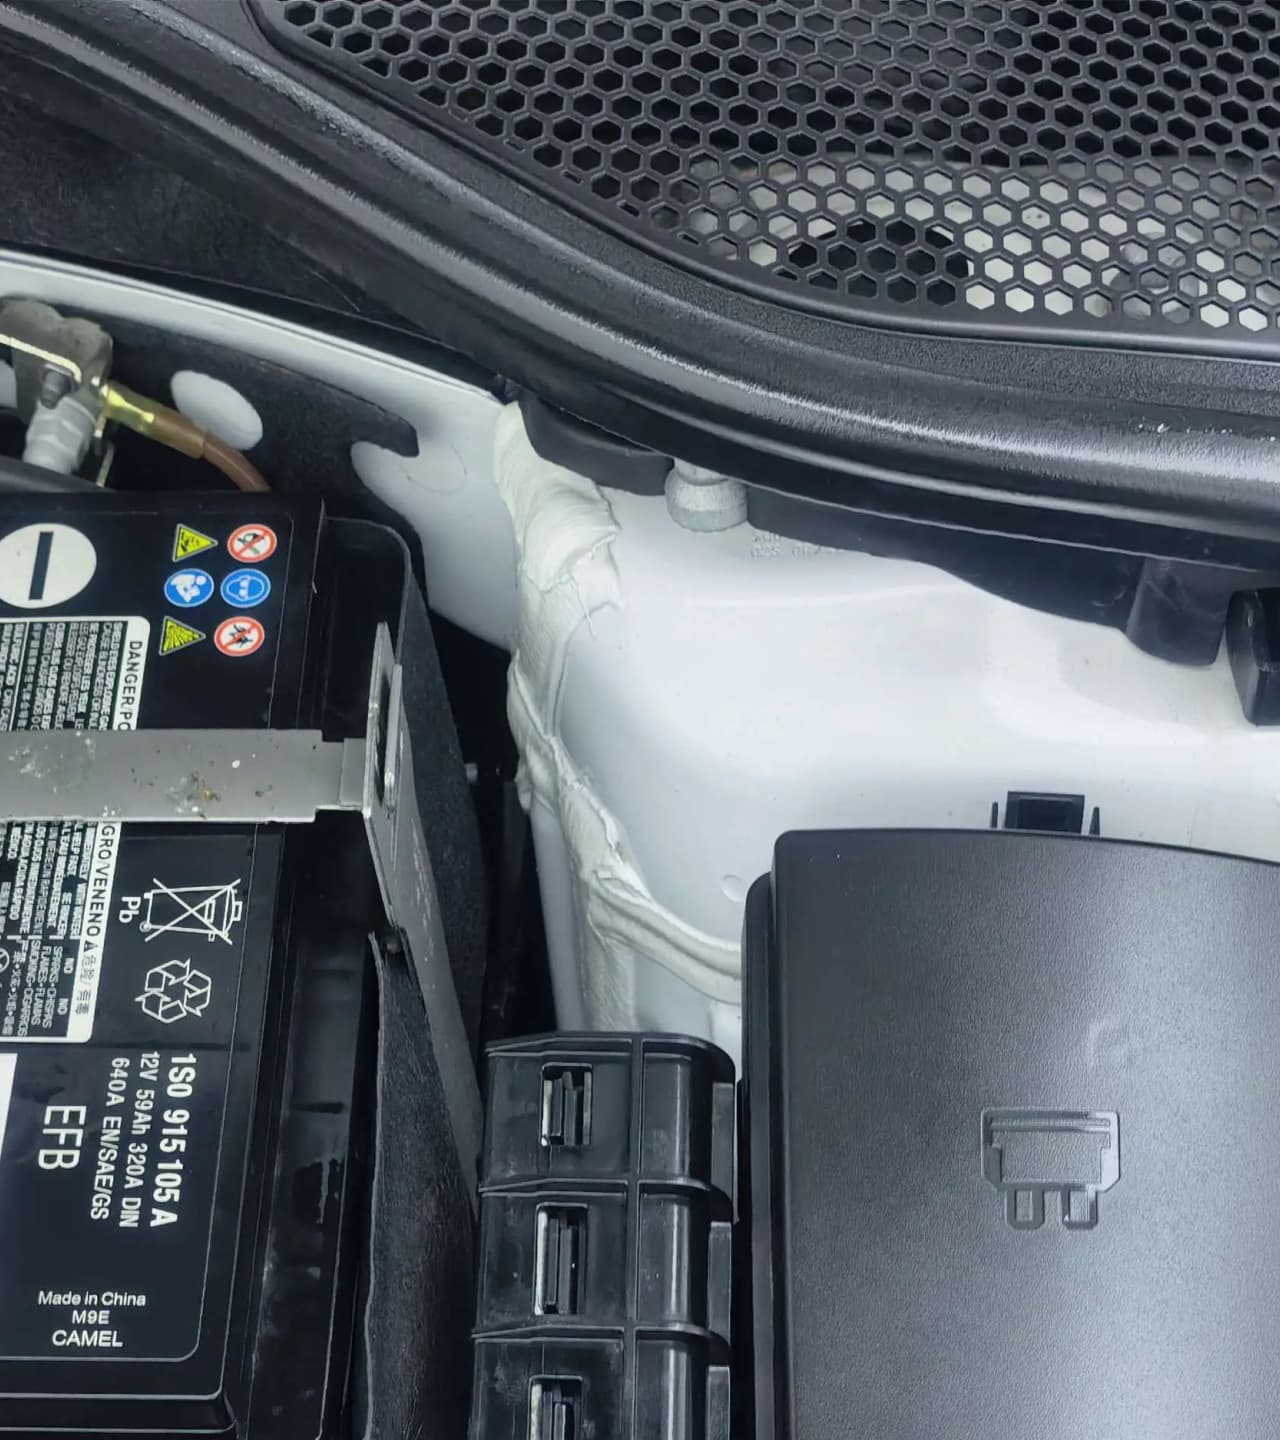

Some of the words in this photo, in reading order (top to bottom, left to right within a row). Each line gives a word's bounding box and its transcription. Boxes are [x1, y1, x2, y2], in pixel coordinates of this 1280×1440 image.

[119, 896, 141, 923] Pb
[63, 957, 75, 973] NO
[56, 998, 69, 1014] NO
[137, 1051, 160, 1081] 12V
[165, 1053, 198, 1097] 1S0
[105, 1057, 130, 1106] 640A
[130, 1089, 155, 1134] 59Ah
[36, 1105, 86, 1170] EFB
[158, 1109, 190, 1152] 915
[89, 1116, 122, 1219] EN/SAE/GS
[123, 1142, 148, 1189] 320A
[151, 1159, 184, 1202] 105
[118, 1197, 141, 1227] DIN
[149, 1208, 178, 1227] A
[38, 1290, 81, 1306] Made
[84, 1291, 98, 1306] in
[101, 1291, 146, 1306] China
[72, 1309, 110, 1324] M9E
[52, 1329, 123, 1347] CAMEL
